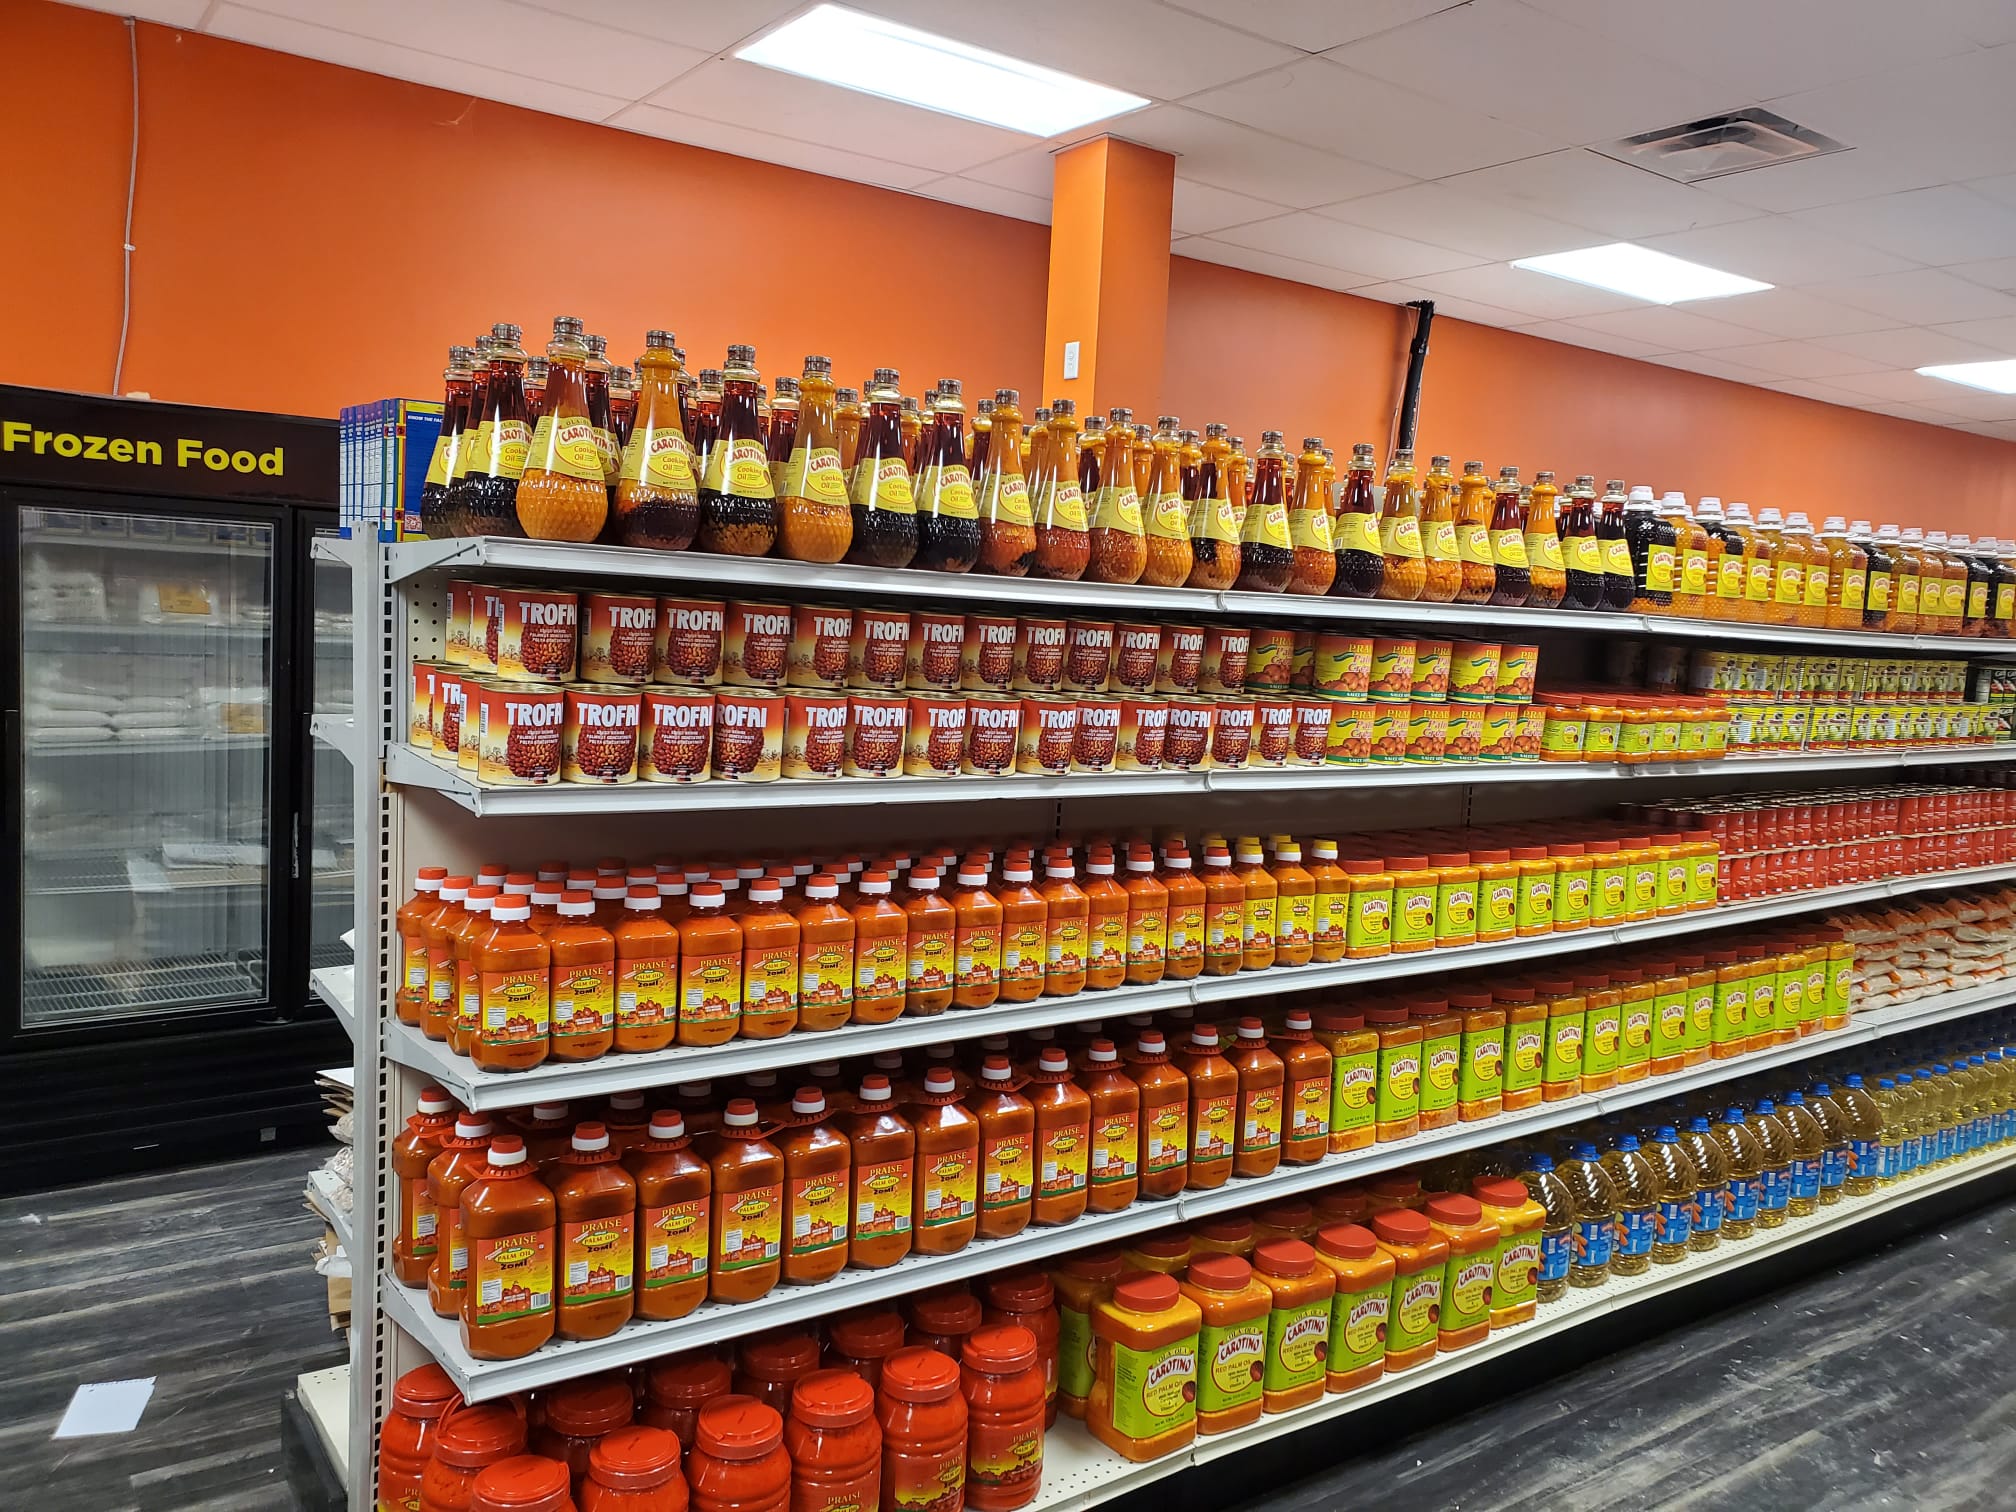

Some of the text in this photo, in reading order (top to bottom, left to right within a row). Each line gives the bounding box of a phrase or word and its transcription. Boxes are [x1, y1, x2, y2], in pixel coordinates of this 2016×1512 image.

[561, 425, 594, 442] CAROTIN
[2, 420, 285, 477] Frozen Food
[574, 446, 596, 456] Cooking
[662, 456, 686, 466] Cooking
[737, 466, 762, 475] Cooking
[737, 473, 747, 481] Oil
[519, 601, 577, 626] TROFA
[505, 702, 564, 727] TROFA
[715, 703, 767, 728] ROFAI
[1221, 904, 1243, 912] PRAISE
[1059, 919, 1083, 928] PRAISE
[1102, 916, 1124, 924] PRAISE
[970, 929, 997, 937] PRAISE
[1018, 925, 1043, 933] PRAISE
[872, 938, 899, 948] PRAISE
[922, 932, 949, 942] PRAISE
[817, 944, 847, 954] PRAISE
[762, 951, 793, 960] PRAISE
[632, 960, 667, 971] PRAISE
[700, 957, 734, 968] PRAISE
[569, 967, 604, 978] PRAISE
[502, 973, 539, 985] PRAISE
[1476, 1043, 1500, 1058] CAROTINO
[1432, 1051, 1456, 1066] CAROTINO
[1392, 1059, 1417, 1075] CAROTINO
[1345, 1069, 1373, 1085] CAROTINO
[1303, 1079, 1325, 1090] PRAISE
[1255, 1089, 1276, 1099] PRAISE
[1158, 1104, 1182, 1116] PRAISE
[1208, 1098, 1231, 1110] PRAISE
[1104, 1115, 1131, 1126] PRAISE
[1053, 1126, 1081, 1139] PRAISE
[995, 1136, 1025, 1149] PRAISE
[937, 1152, 967, 1164] PRAISE
[870, 1164, 902, 1176] PRAISE
[805, 1174, 838, 1188] PRAISE
[737, 1188, 773, 1203] PRAISE
[807, 1188, 833, 1199] PALM OIL
[662, 1203, 699, 1218] PRAISE
[740, 1203, 767, 1214] PALM OIL
[581, 1218, 622, 1233] PRAISE
[664, 1218, 694, 1229] PALM OIL
[495, 1234, 537, 1250] PRAISE
[584, 1233, 616, 1245] PALM OIL
[497, 1252, 517, 1261] PALM
[1504, 1247, 1536, 1266] CAROTINO
[1459, 1265, 1492, 1285] CAROTINO
[1406, 1282, 1439, 1305] CAROTINO
[1352, 1301, 1385, 1323] CAROTINO
[1287, 1316, 1325, 1341] CAROTINO
[1220, 1337, 1260, 1361] CAROTINO
[1294, 1342, 1307, 1350] PALM
[1151, 1358, 1191, 1384] CAROTINO
[1228, 1361, 1243, 1371] PALM
[1158, 1382, 1173, 1394] PALM
